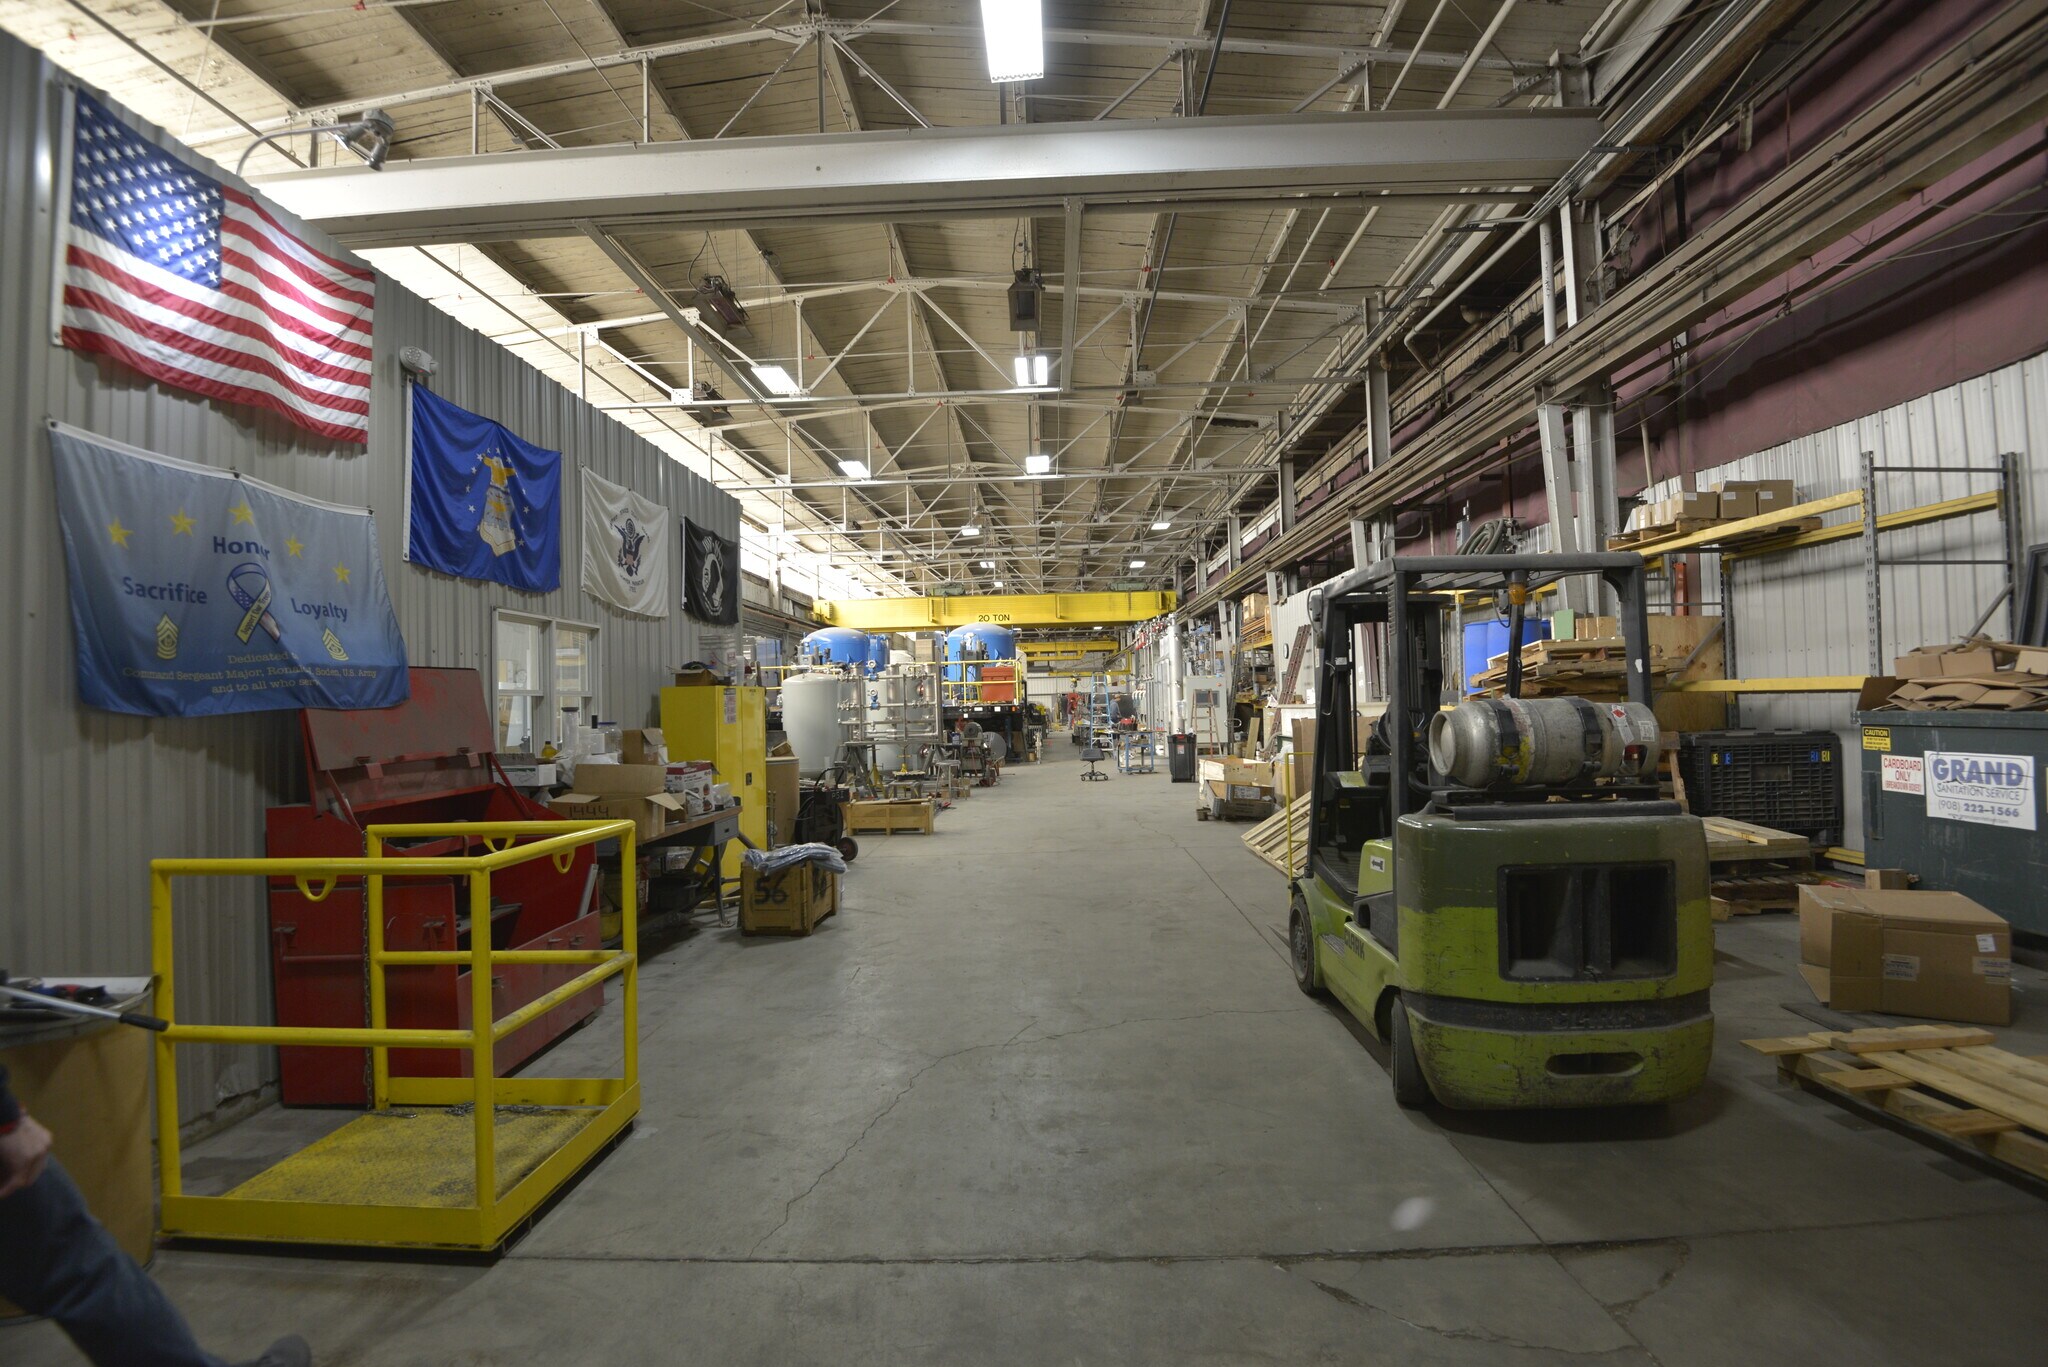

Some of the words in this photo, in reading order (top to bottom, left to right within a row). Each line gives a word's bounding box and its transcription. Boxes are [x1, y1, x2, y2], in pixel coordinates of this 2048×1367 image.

[123, 577, 207, 605] Sacrifice
[291, 597, 348, 622] Loyalty
[978, 614, 990, 622] 20
[228, 652, 286, 664] Dedicated
[176, 671, 224, 682] Sergeant
[226, 670, 265, 679] Major,
[212, 685, 234, 694] and
[236, 683, 249, 692] to
[251, 680, 266, 690] all
[270, 679, 296, 689] who
[1864, 729, 1888, 737] CAUTION
[1884, 757, 1921, 771] CARDBOARD
[1895, 770, 1910, 781] ONLY
[1933, 758, 2023, 786] GRAND
[1937, 782, 1983, 797] SANITATION
[1986, 788, 2020, 801] SERVICE
[569, 805, 609, 817] 1444
[1939, 799, 1961, 812] (908)
[1964, 803, 2019, 817] 222-1566
[754, 869, 790, 906] 56
[1344, 930, 1365, 960] CLARK
